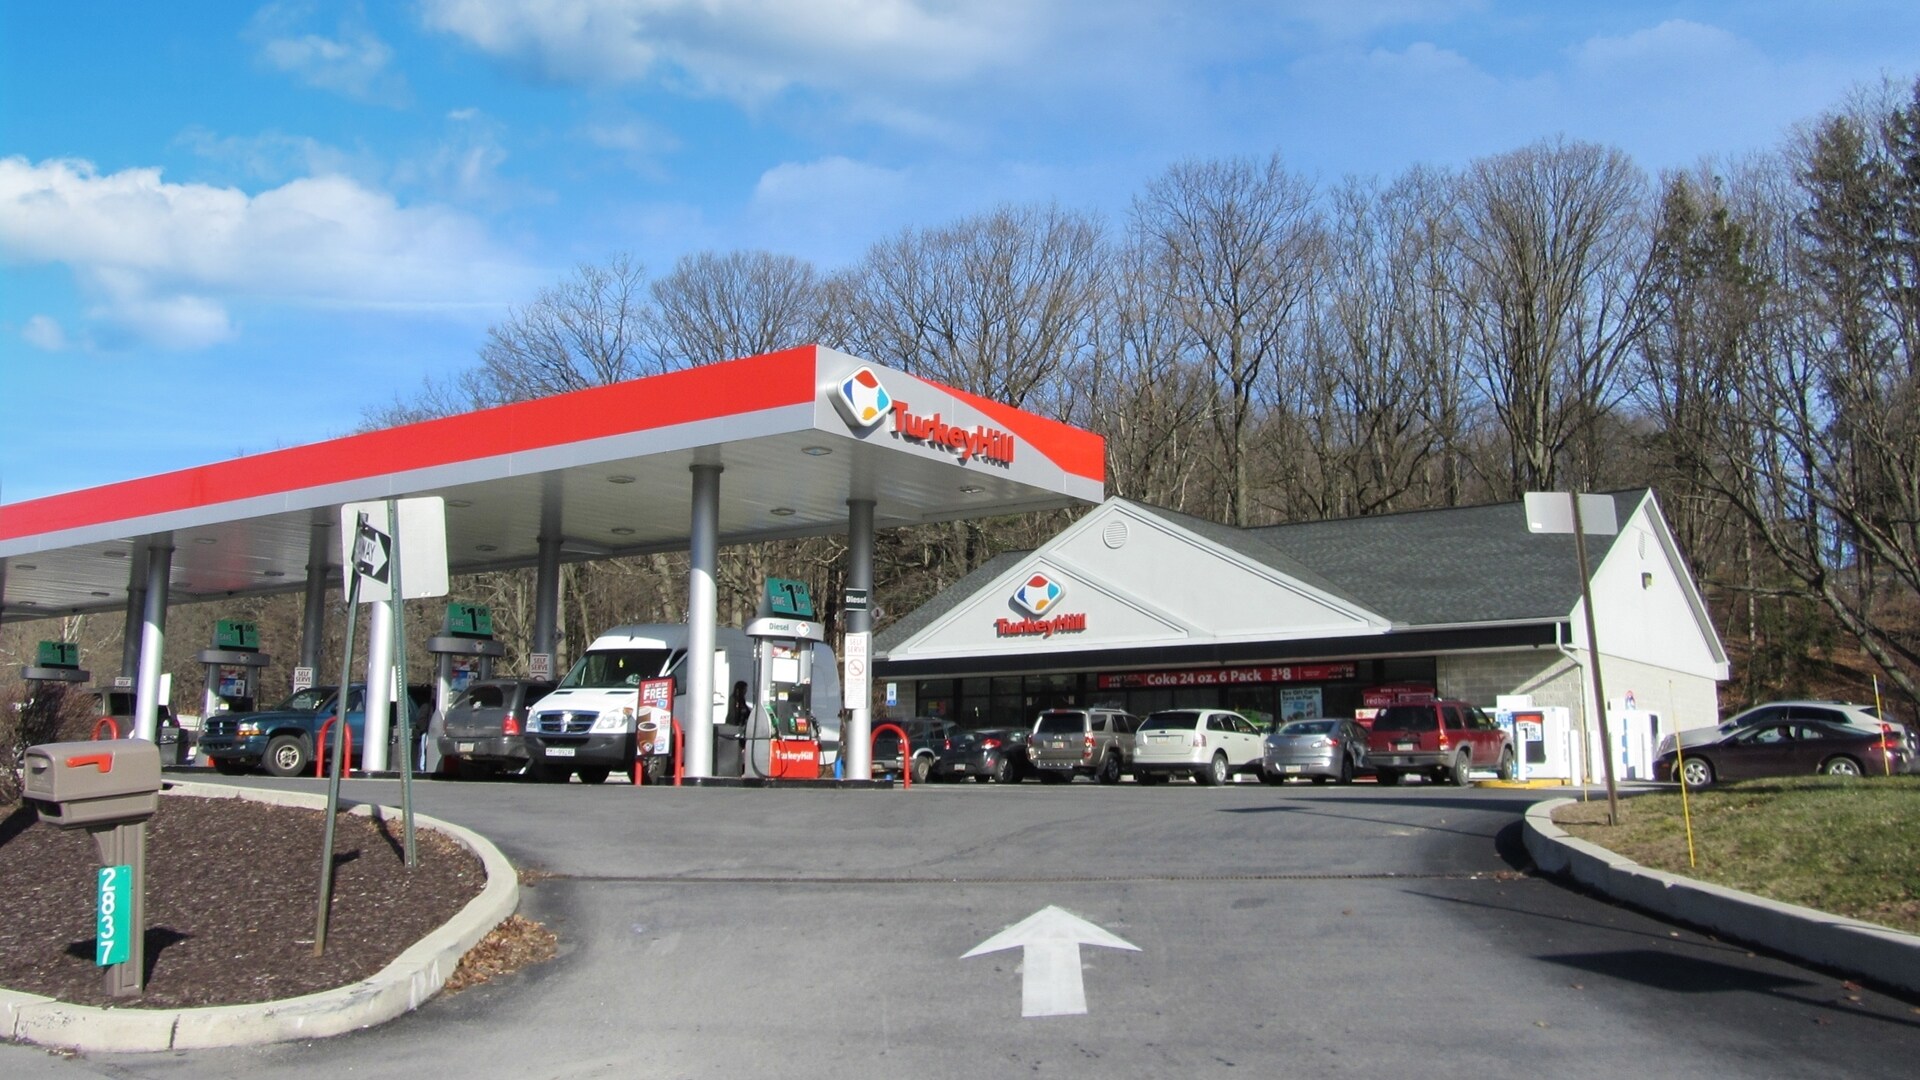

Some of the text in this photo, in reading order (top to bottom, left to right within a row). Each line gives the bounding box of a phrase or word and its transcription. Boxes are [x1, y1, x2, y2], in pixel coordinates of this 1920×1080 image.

[846, 595, 867, 604] Diesel
[769, 622, 789, 631] Diesel
[847, 645, 865, 653] SERVE
[1147, 673, 1178, 686] Coke
[1179, 673, 1194, 684] 24
[1197, 673, 1217, 683] oz.
[1219, 671, 1228, 682] 6
[1230, 669, 1262, 681] Pack
[643, 687, 669, 700] FREE
[100, 867, 117, 965] 2837
